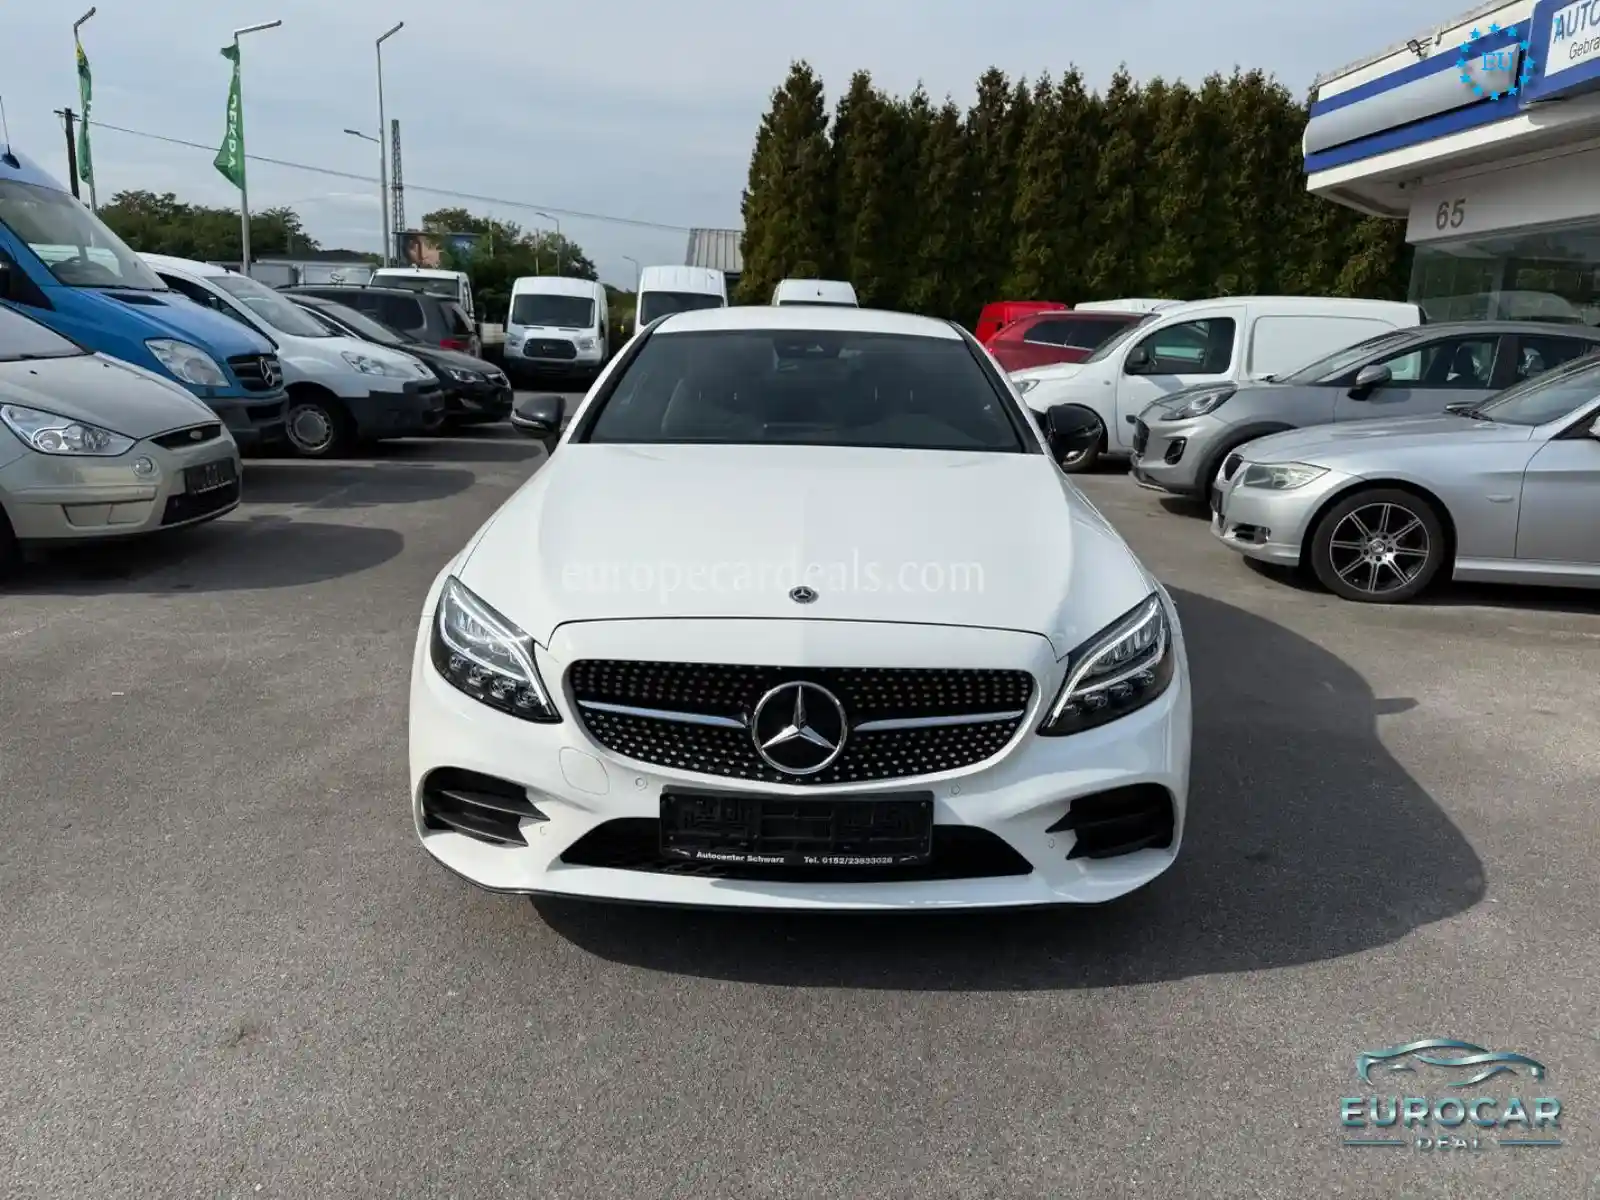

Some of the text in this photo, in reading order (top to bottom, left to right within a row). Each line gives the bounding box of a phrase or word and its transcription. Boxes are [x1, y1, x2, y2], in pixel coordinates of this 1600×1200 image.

[1436, 198, 1466, 230] 65
[696, 851, 784, 863] Autocenter Schwarz
[804, 856, 819, 864] Tel.
